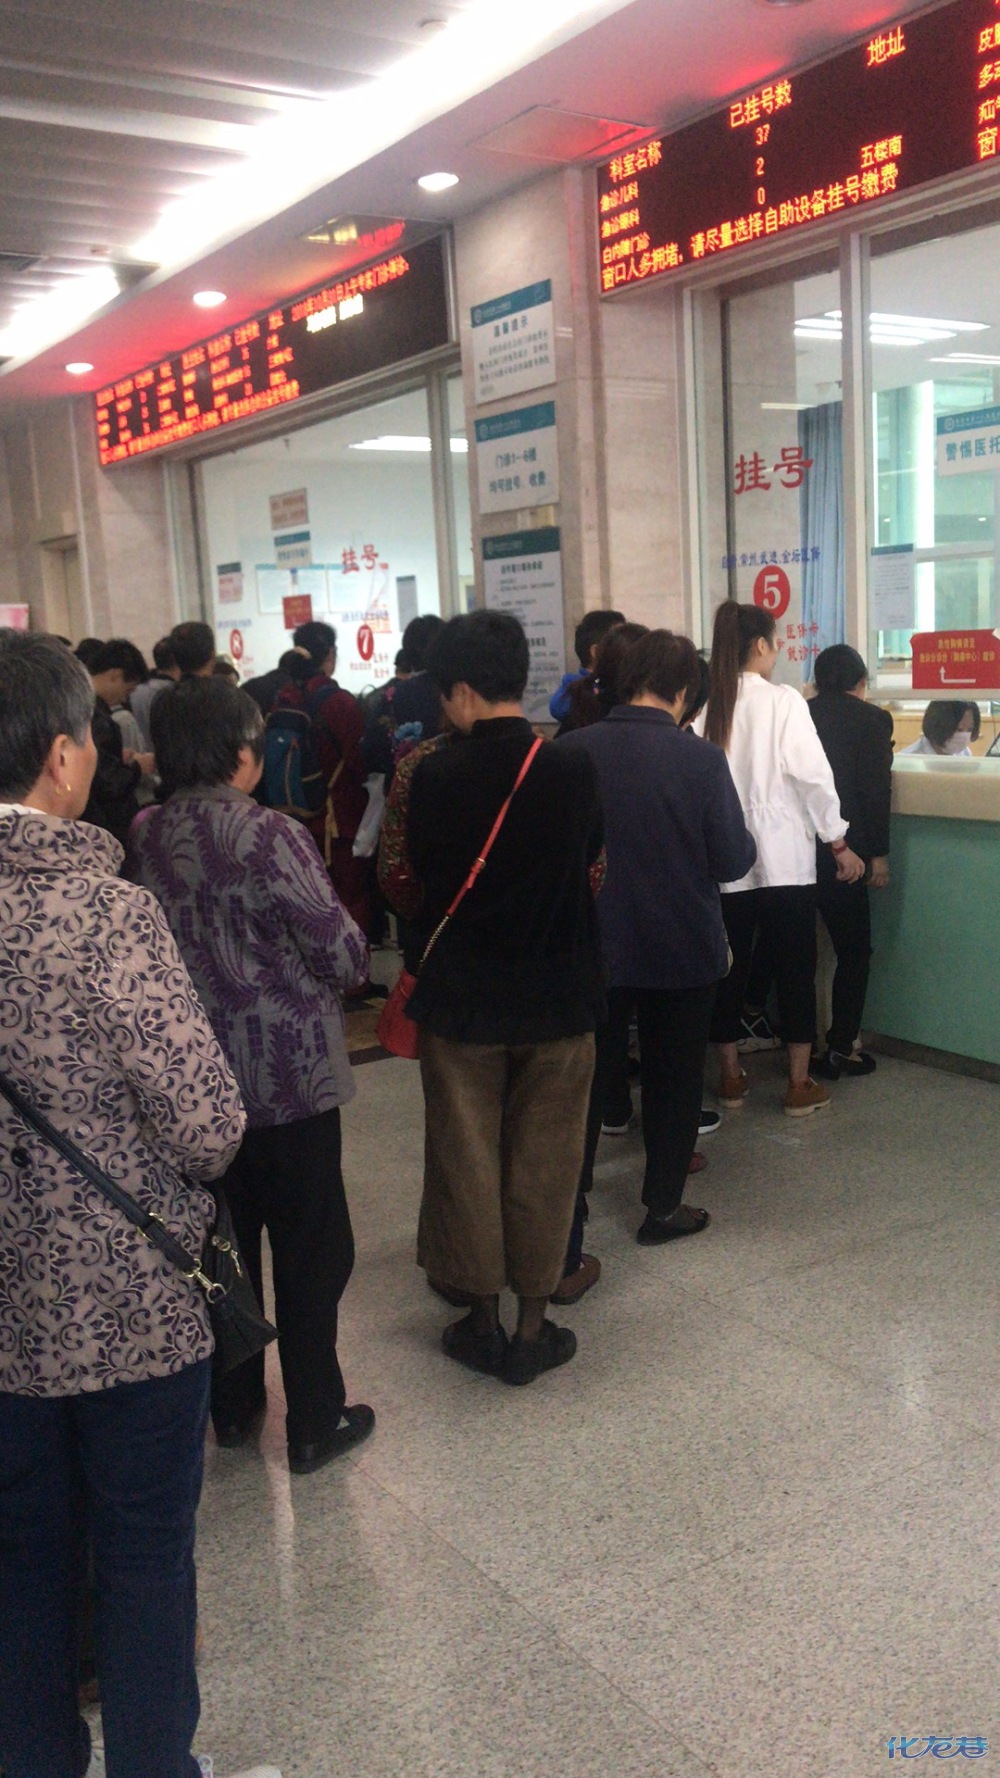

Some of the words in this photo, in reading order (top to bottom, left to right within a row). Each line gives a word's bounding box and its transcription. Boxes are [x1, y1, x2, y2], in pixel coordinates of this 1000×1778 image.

[867, 26, 906, 66] 地址
[730, 80, 792, 127] 已挂号数
[755, 123, 771, 145] 37
[609, 141, 662, 183] 科室名称
[756, 157, 765, 175] 2
[861, 135, 902, 168] 五楼南
[757, 187, 766, 204] 0
[734, 446, 814, 494] 挂号
[342, 544, 379, 574] 挂号
[763, 574, 782, 610] 5
[786, 621, 820, 640] 医保卡
